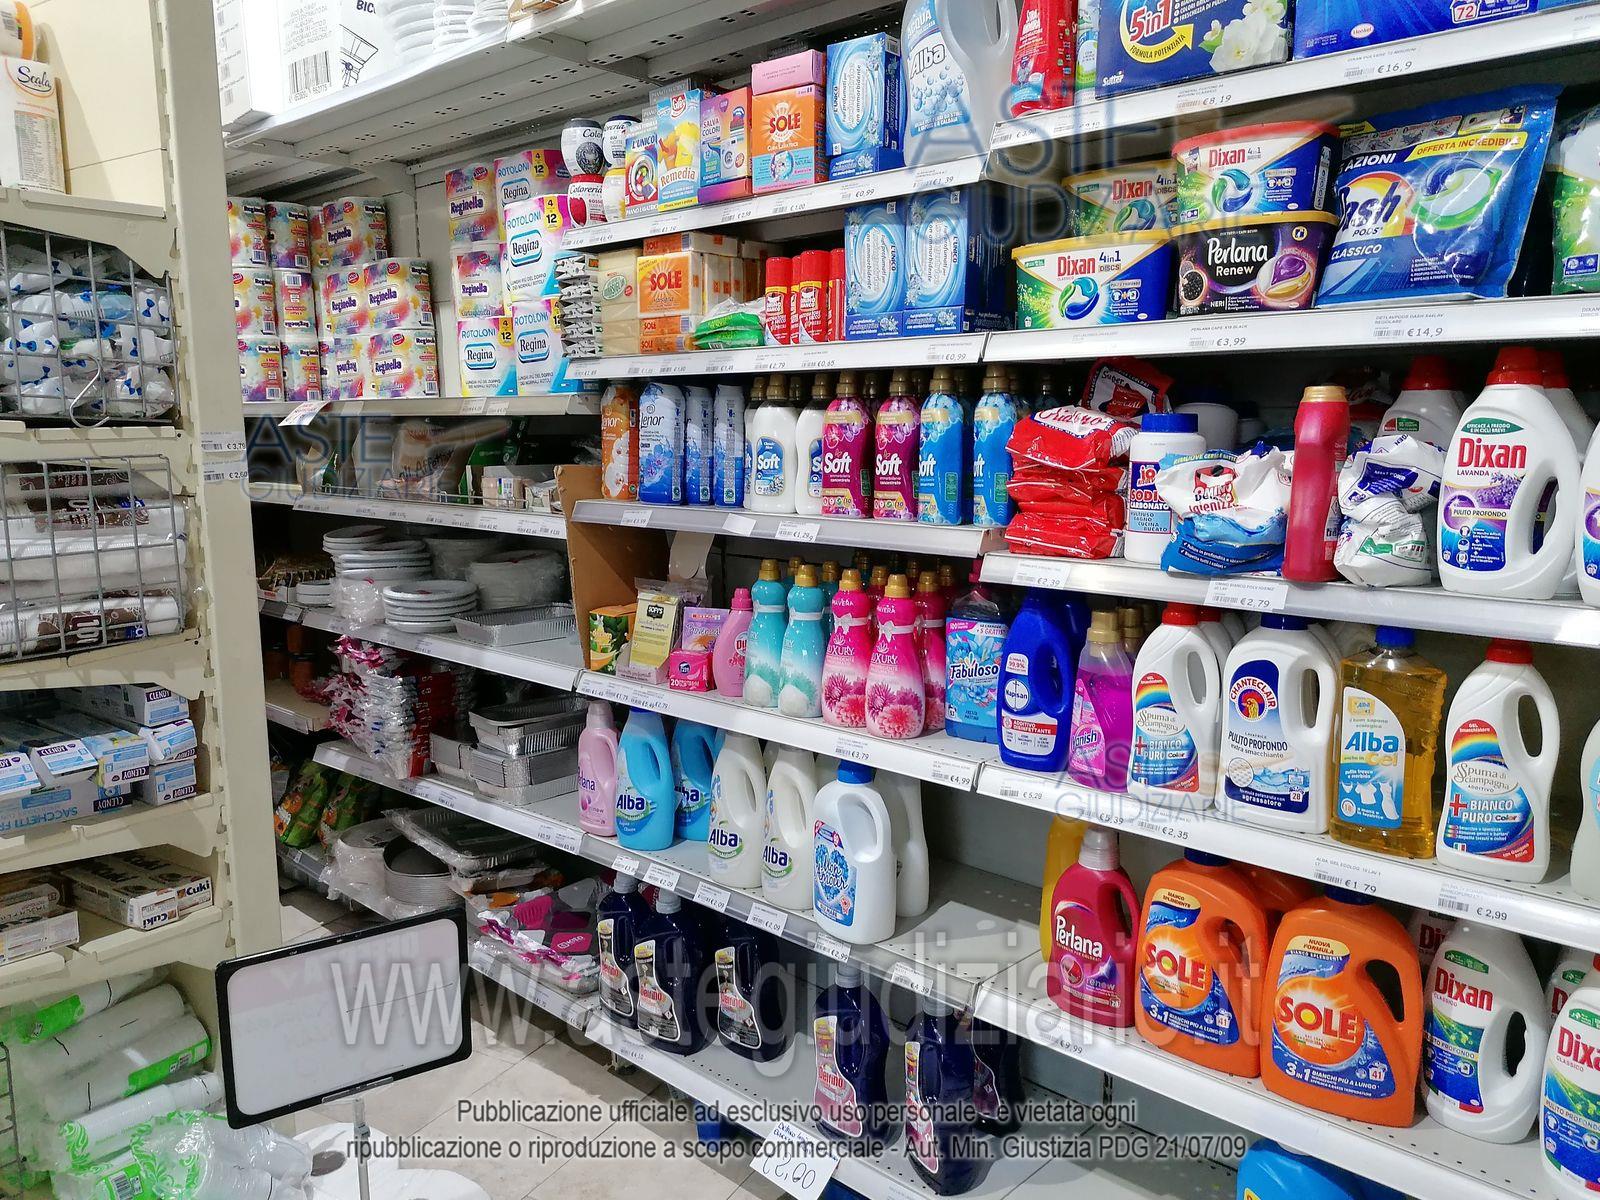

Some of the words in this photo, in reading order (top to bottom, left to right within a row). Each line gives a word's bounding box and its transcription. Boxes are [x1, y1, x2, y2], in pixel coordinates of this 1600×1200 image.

[1456, 5, 1474, 20] 72
[1353, 25, 1372, 35] Henkel
[1130, 45, 1153, 58] FORMULA
[1154, 34, 1186, 57] POTENZIATA
[910, 44, 946, 80] Alba
[1378, 61, 1412, 73] €16,9
[17, 65, 52, 89] Scala
[1102, 70, 1124, 86] Sutter
[1203, 94, 1232, 106] €8,19
[703, 118, 720, 129] SALVA
[769, 112, 801, 134] SOLE
[702, 126, 720, 138] COLORI
[1416, 141, 1457, 156] OFFERTA
[1208, 148, 1246, 168] Dixan
[1345, 153, 1397, 172] AZIONI
[497, 163, 530, 177] ROTOLONI
[534, 165, 544, 174] 12
[661, 169, 696, 188] Remedia
[503, 184, 529, 200] Regina
[856, 188, 875, 198] €0,99
[1112, 179, 1153, 201] Dixan
[450, 196, 484, 215] Reginella
[507, 210, 542, 229] ROTOLONI
[546, 213, 558, 223] 12
[327, 226, 352, 244] Reginella
[512, 239, 540, 256] Regina
[1207, 237, 1268, 266] Perlana
[1331, 244, 1383, 260] CLASSICO
[1057, 255, 1096, 277] Dixan
[1099, 250, 1121, 263] 4in1
[1099, 264, 1121, 272] DISCS
[1216, 265, 1254, 276] Renew
[649, 269, 682, 291] SOLE
[369, 285, 397, 304] Reginella
[462, 282, 488, 296] Reginella
[332, 297, 357, 313] Reginella
[514, 312, 549, 326] ROTOLONI
[461, 328, 496, 339] ROTOLONI
[501, 332, 512, 340] 12
[1407, 327, 1443, 337] €14,9
[520, 338, 547, 352] Regina
[1216, 337, 1246, 347] €3,99
[467, 350, 493, 361] Regina
[375, 358, 402, 373] Reginella
[1102, 372, 1125, 386] Super
[640, 412, 665, 429] Lenor
[1457, 437, 1527, 469] Dixan
[757, 453, 780, 470] Soft
[824, 452, 852, 474] Soft
[876, 453, 903, 476] Soft
[1472, 509, 1507, 518] PROFONDO
[1037, 576, 1060, 588] €2,39
[1240, 597, 1270, 608] €2,79
[950, 663, 999, 681] Fabuloso
[149, 690, 171, 701] CLENDY
[1006, 689, 1028, 700] Napisan
[1230, 678, 1277, 708] CHANTECLAIR
[1012, 719, 1036, 728] ADDITIVO
[1137, 711, 1171, 722] Spuma
[1013, 724, 1052, 735] DISINFETTANTE
[1149, 740, 1181, 750] BIANCO
[1228, 731, 1249, 747] PULITO
[1248, 740, 1288, 751] PROFONDO
[1345, 732, 1399, 754] Alba
[40, 746, 66, 757] CLENDY
[851, 747, 869, 760] €3,79
[1144, 751, 1165, 760] PURO
[1231, 744, 1244, 752] extra
[1245, 749, 1284, 759] smacchiante
[1365, 753, 1398, 767] Gel
[123, 767, 147, 780] CLENDY
[1455, 762, 1498, 779] Spuma
[950, 776, 971, 786] €4,99
[1454, 775, 1510, 791] Sciampagna
[1467, 784, 1495, 792] ADDITIVO
[173, 786, 195, 798] CLENDY
[1292, 792, 1301, 801] 28
[97, 796, 124, 811] CLENDY
[615, 794, 646, 811] Alba
[1242, 794, 1282, 807] sgrassatore
[1470, 799, 1514, 811] BIANCO
[15, 806, 78, 828] SACCHETTI
[1100, 813, 1124, 825] €5,39
[1462, 812, 1492, 823] PURO
[1495, 814, 1517, 822] Color
[709, 828, 739, 847] Alba
[1162, 827, 1189, 840] €2,35
[762, 845, 788, 866] Alba
[186, 880, 210, 896] Cuki
[659, 880, 674, 888] €2,09
[1162, 895, 1191, 909] SPLENDENTE
[1167, 891, 1185, 901] BIANCO
[143, 913, 168, 928] Cuki
[1485, 908, 1508, 920] 2,99
[765, 921, 781, 931] €2,09
[1055, 915, 1103, 959] Perlana
[1308, 938, 1331, 948] NUOVA
[830, 948, 848, 960] €2,99
[1303, 943, 1334, 955] FORMULA
[1144, 942, 1207, 991] SOLE
[909, 983, 930, 995] €4,39
[1086, 978, 1116, 990] renew
[1434, 966, 1494, 1012] Dixan
[1433, 993, 1458, 1007] CLASSICO
[1279, 996, 1358, 1044] SOLE
[1203, 1025, 1223, 1036] LUNGO
[1060, 1040, 1083, 1054] €9,99
[1441, 1042, 1475, 1059] PROFONDO
[1557, 1026, 1600, 1071] Dixa
[1555, 1055, 1585, 1072] CLASSICO
[1311, 1070, 1338, 1083] BIANCHI
[1355, 1081, 1377, 1090] LUNGO
[1372, 1070, 1382, 1079] 41
[1545, 1100, 1565, 1115] PULITO
